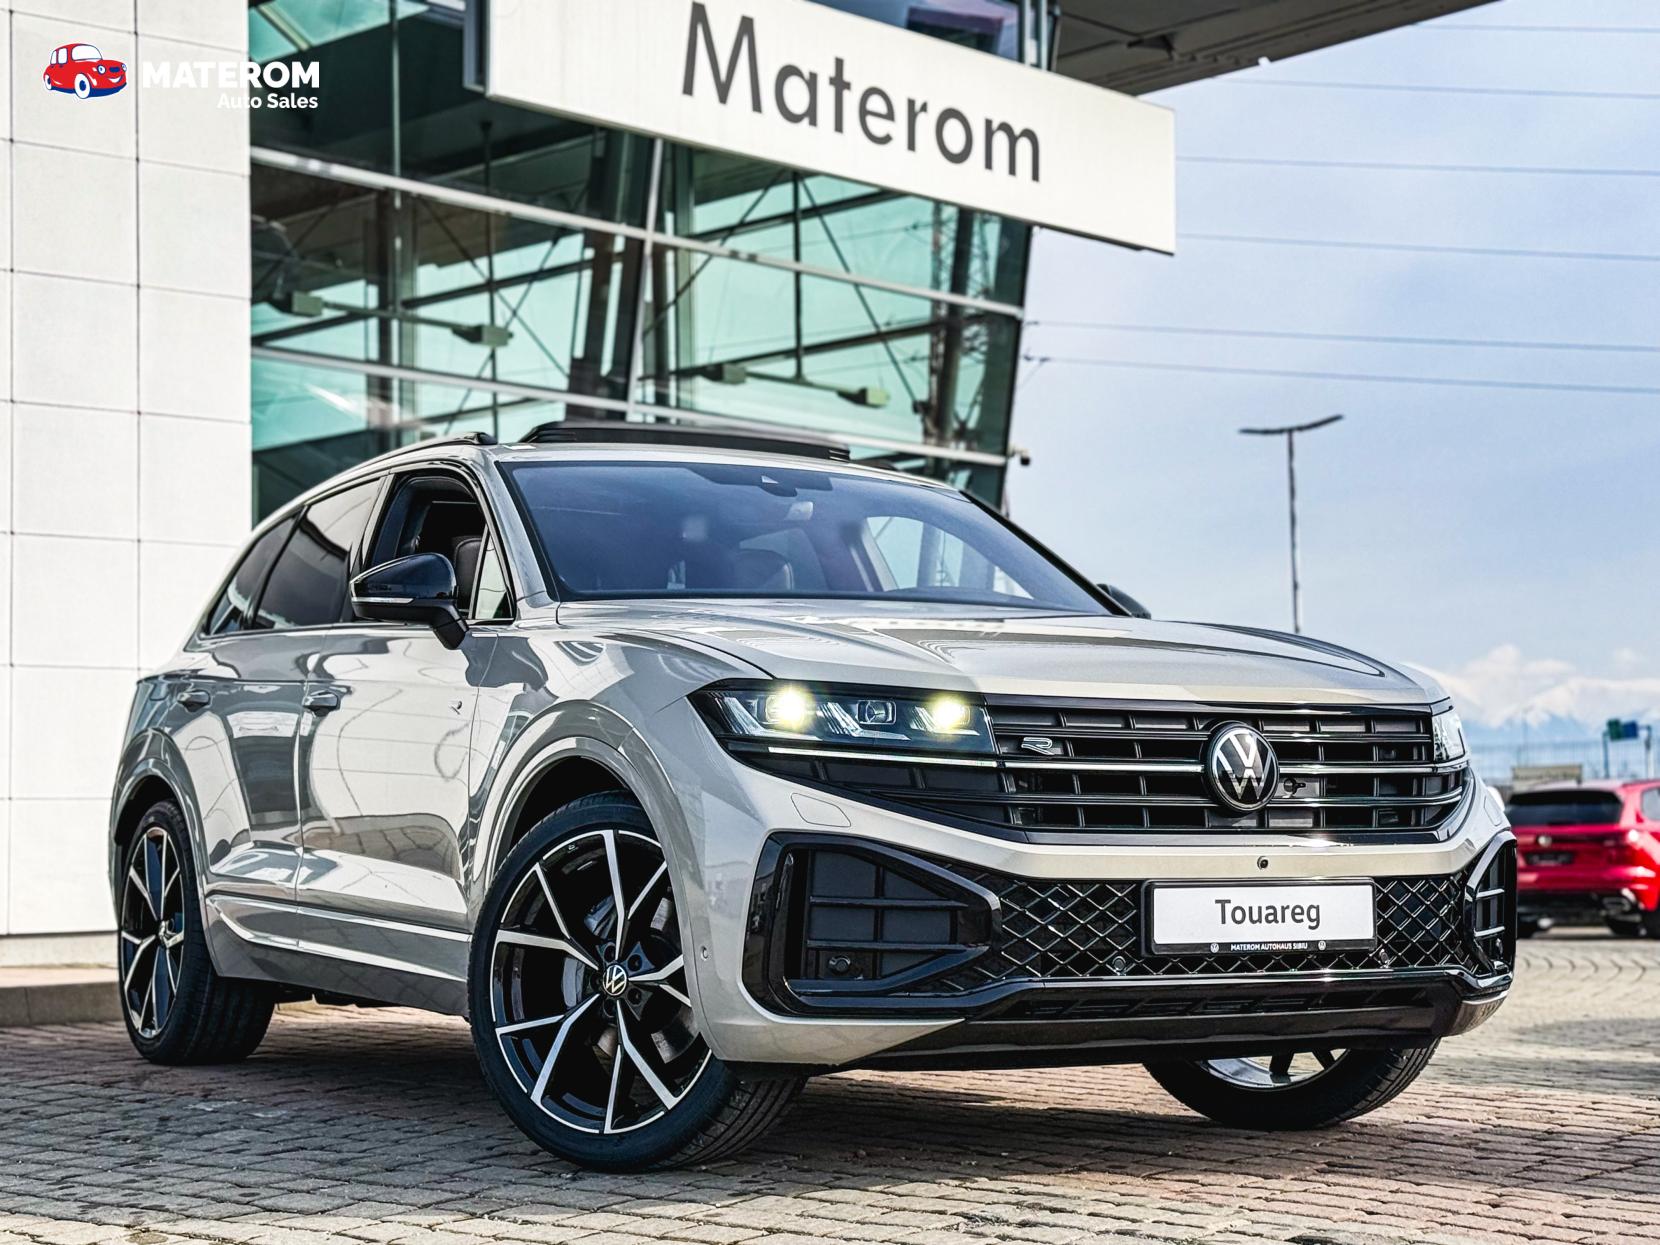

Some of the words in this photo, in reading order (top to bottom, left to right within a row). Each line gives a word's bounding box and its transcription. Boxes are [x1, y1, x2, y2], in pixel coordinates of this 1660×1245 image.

[682, 1, 1040, 183] Materom
[1214, 899, 1321, 931] Touareg
[1230, 943, 1260, 952] MATEROM
[1260, 942, 1293, 951] AUTOHAUS
